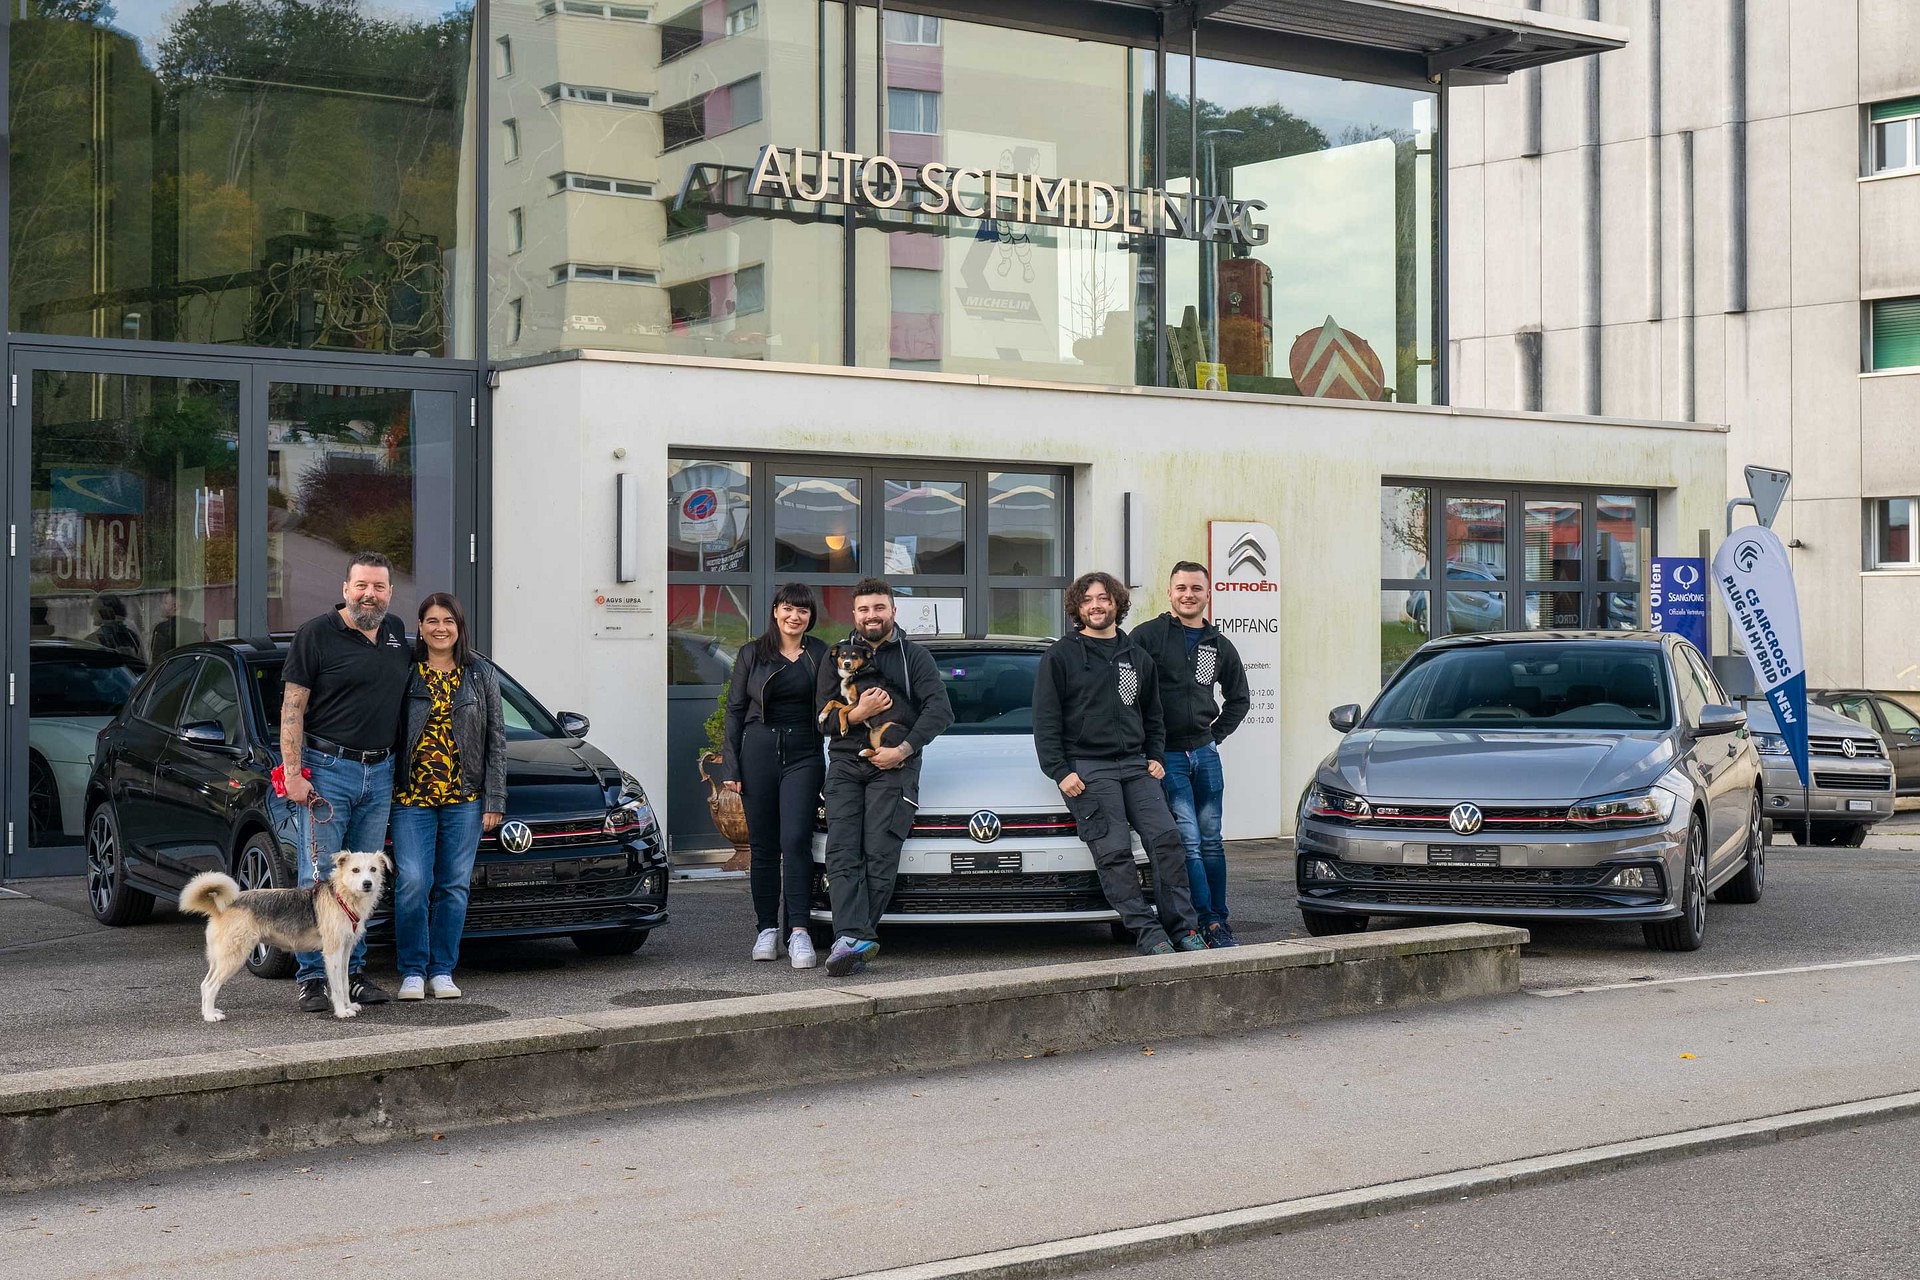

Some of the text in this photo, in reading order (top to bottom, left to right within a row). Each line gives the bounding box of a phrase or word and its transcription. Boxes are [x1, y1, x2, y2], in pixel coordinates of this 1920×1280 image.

[749, 143, 1270, 246] AUTO SCHMIDLIN AG
[966, 296, 1031, 310] MICHELIN
[55, 519, 141, 580] SIMCA
[1651, 563, 1662, 607] Olten
[1214, 618, 1278, 633] EMPFANG
[1723, 575, 1778, 684] PLUG-IN HYBRID
[1745, 588, 1792, 678] C5 AIRCROSS
[1773, 689, 1798, 725] NEW
